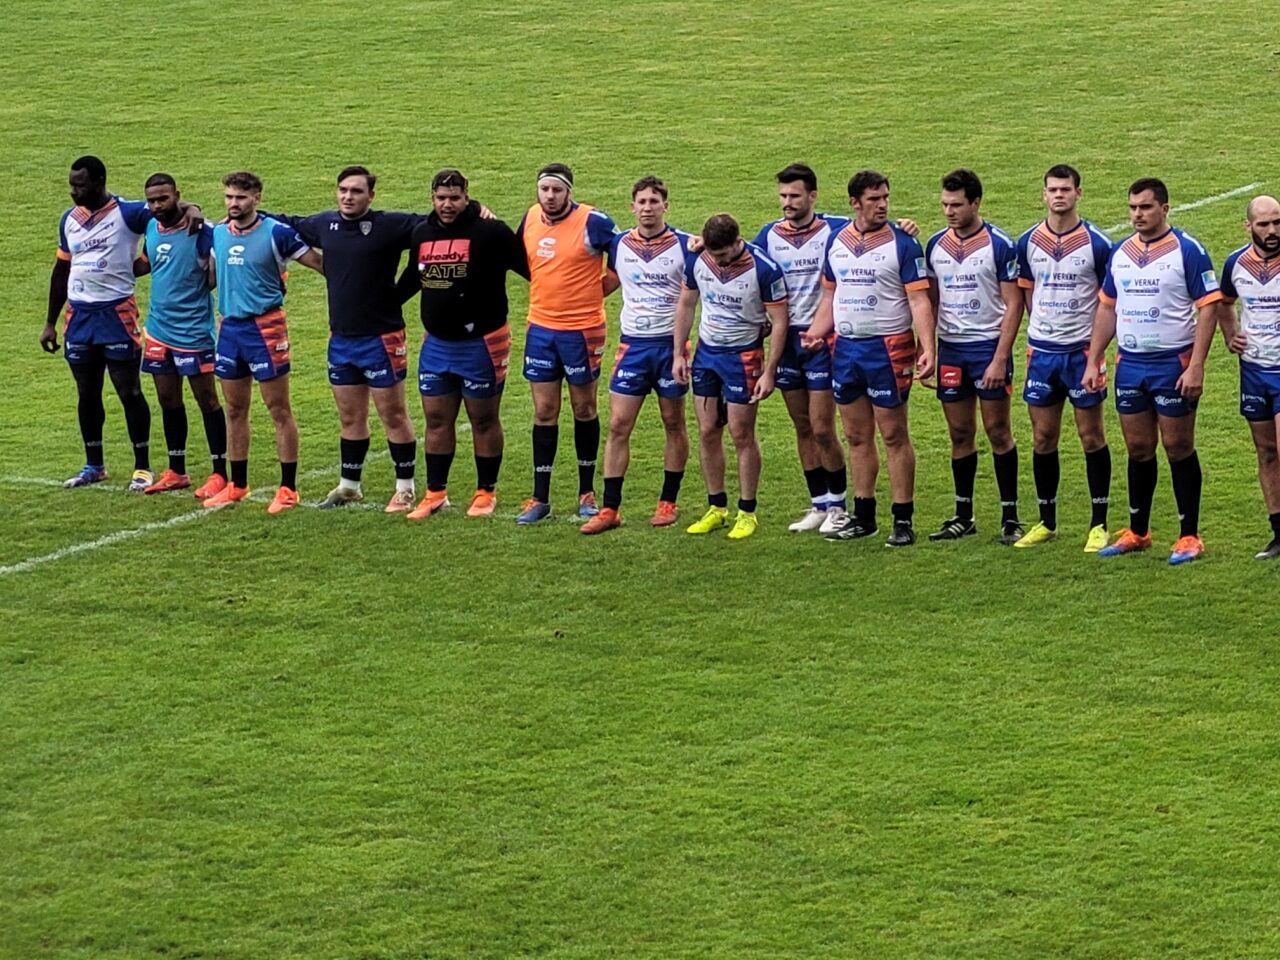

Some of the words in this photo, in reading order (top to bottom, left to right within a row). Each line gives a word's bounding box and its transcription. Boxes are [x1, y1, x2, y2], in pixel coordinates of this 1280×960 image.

[795, 257, 820, 267] VERNAT
[851, 268, 876, 277] VERNAT
[1134, 278, 1160, 287] VERNAT
